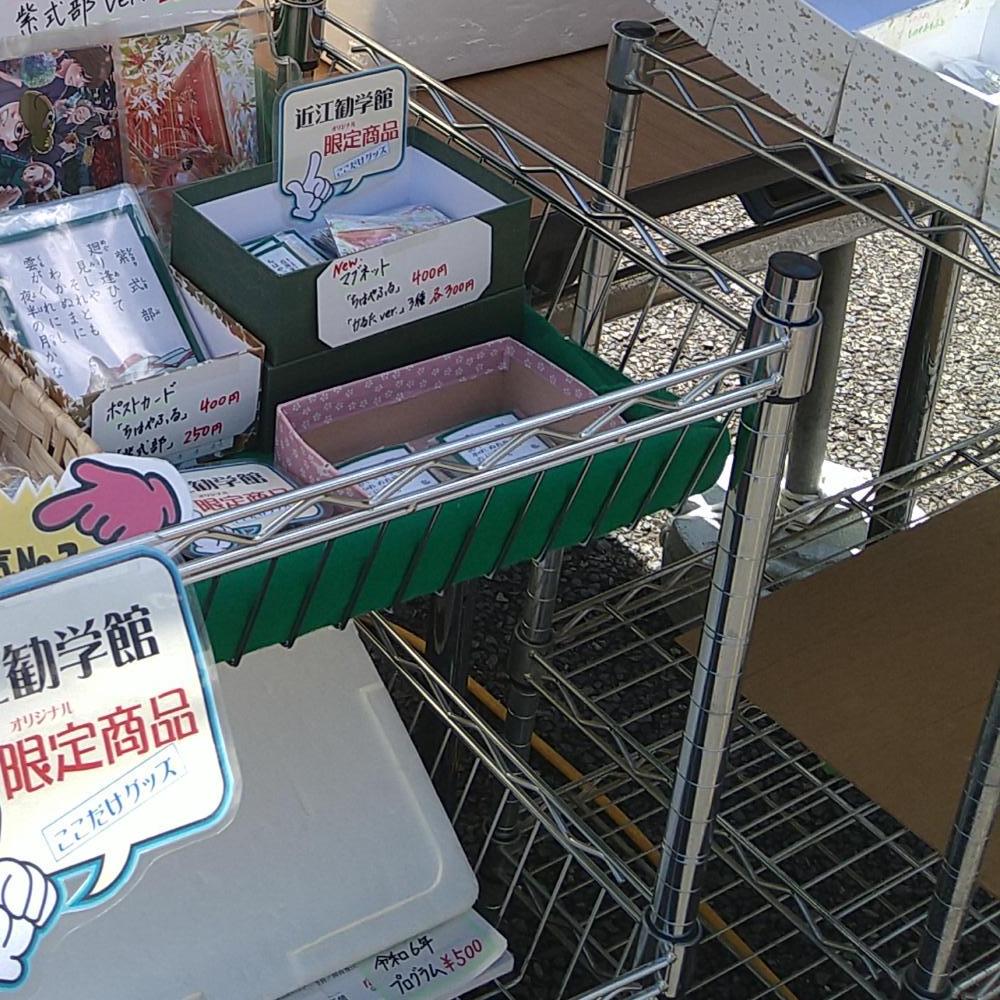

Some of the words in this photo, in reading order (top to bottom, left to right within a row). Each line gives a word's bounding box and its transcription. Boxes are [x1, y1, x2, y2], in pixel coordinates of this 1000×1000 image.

[295, 87, 394, 130] 近江勧学館
[323, 119, 400, 157] 限定商品
[340, 257, 390, 286] マグネット
[412, 263, 448, 286] 400円
[48, 268, 88, 341] わかぬまに
[69, 278, 101, 338] それとも
[106, 381, 177, 423] ポストカード
[200, 390, 240, 414] 400円
[183, 422, 223, 446] 250円
[9, 701, 73, 735] オリジナル
[54, 756, 178, 852] ここだけグッズ
[374, 935, 434, 972] 令和6年
